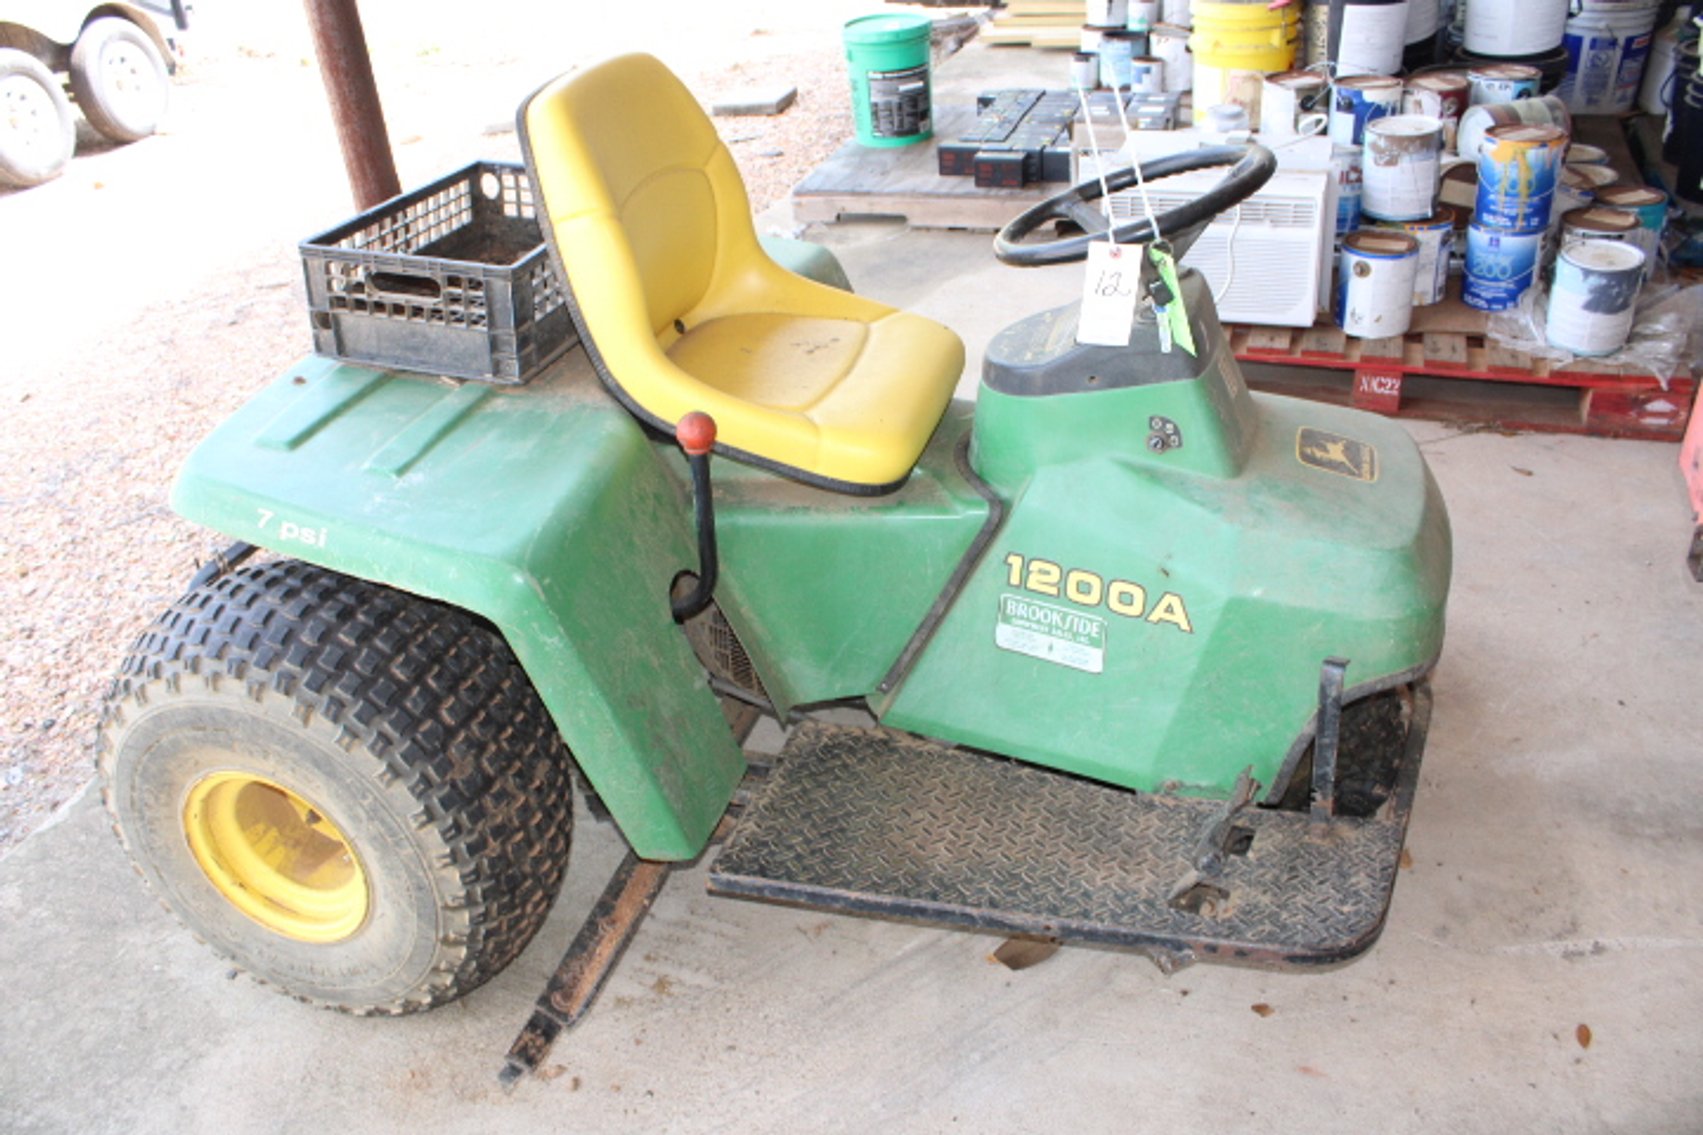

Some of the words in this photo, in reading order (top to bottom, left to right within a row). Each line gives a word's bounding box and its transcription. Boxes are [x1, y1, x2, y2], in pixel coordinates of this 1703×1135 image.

[1095, 269, 1131, 297] 12
[257, 507, 274, 529] 7
[279, 520, 328, 548] psi
[1004, 552, 1194, 634] 1200A
[1006, 598, 1100, 638] BROOKSIDE
